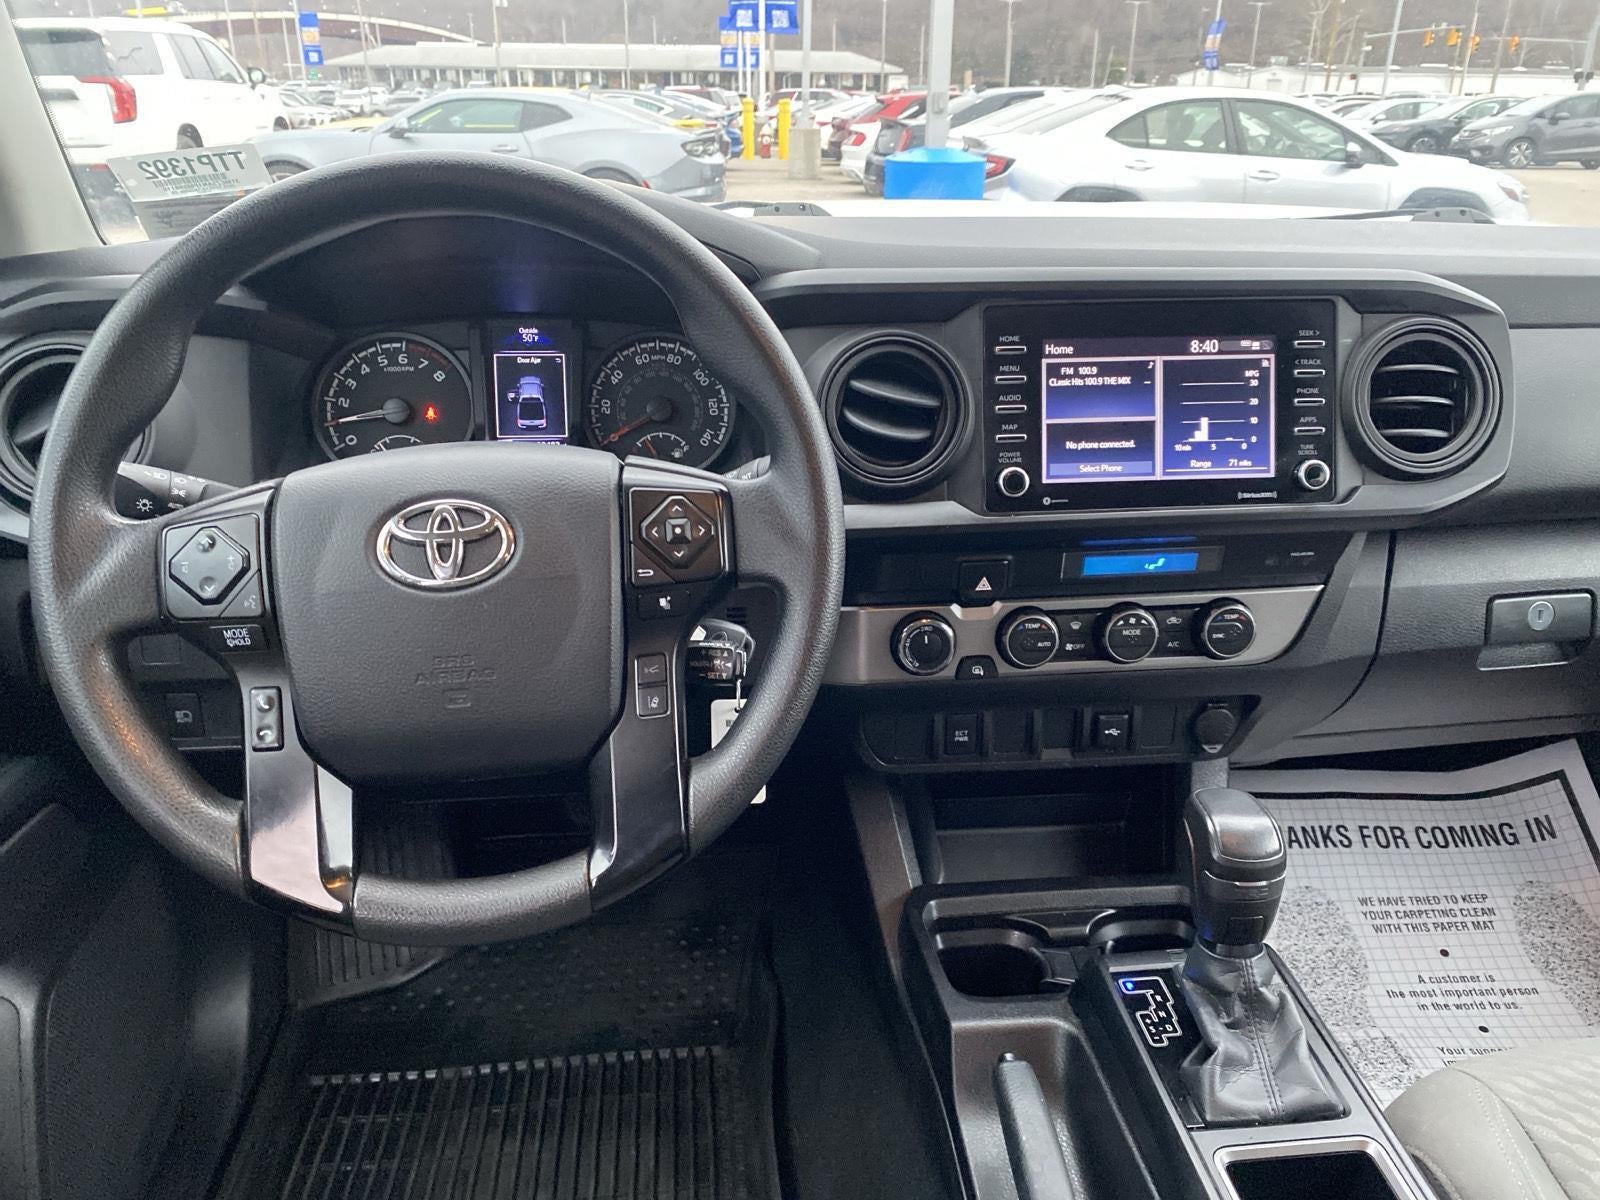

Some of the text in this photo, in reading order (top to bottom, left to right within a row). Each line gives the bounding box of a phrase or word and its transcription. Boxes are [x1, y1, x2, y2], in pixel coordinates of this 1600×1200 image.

[522, 334, 538, 342] 50°F
[1045, 344, 1074, 354] Home
[1190, 340, 1219, 353] 8:40
[378, 355, 388, 366] 5
[398, 354, 408, 364] 6
[418, 358, 429, 369] 7
[635, 354, 650, 365] 60
[666, 354, 682, 365] 80
[361, 364, 370, 376] 4
[1061, 366, 1097, 375] FM 100.9
[434, 370, 446, 382] 8
[610, 370, 624, 385] 40
[692, 368, 710, 386] 100
[1072, 378, 1084, 386] Hits
[1084, 377, 1102, 385] 100.9
[1118, 376, 1132, 384] MIX
[346, 378, 356, 390] 3
[338, 398, 350, 408] 2
[601, 400, 611, 414] 20
[708, 398, 719, 416] 120
[346, 435, 357, 445] 0
[700, 429, 714, 446] 140
[1066, 440, 1136, 450] No phone connected.
[1079, 464, 1122, 472] Select Phone
[1190, 460, 1212, 468] Range
[223, 628, 250, 639] MODE
[1288, 814, 1557, 849] ANKS FOR COMING IN
[1358, 894, 1488, 906] WE HAVE TRIED TO KEEP
[1362, 907, 1496, 920] YOUR CARPETING CLEAN
[1372, 920, 1495, 933] WITH THIS PAPER MAT
[1418, 973, 1496, 984] A customer is
[1386, 986, 1539, 1000] the most important person
[1416, 1001, 1523, 1011] in the world to us.
[1436, 1046, 1466, 1055] Your
